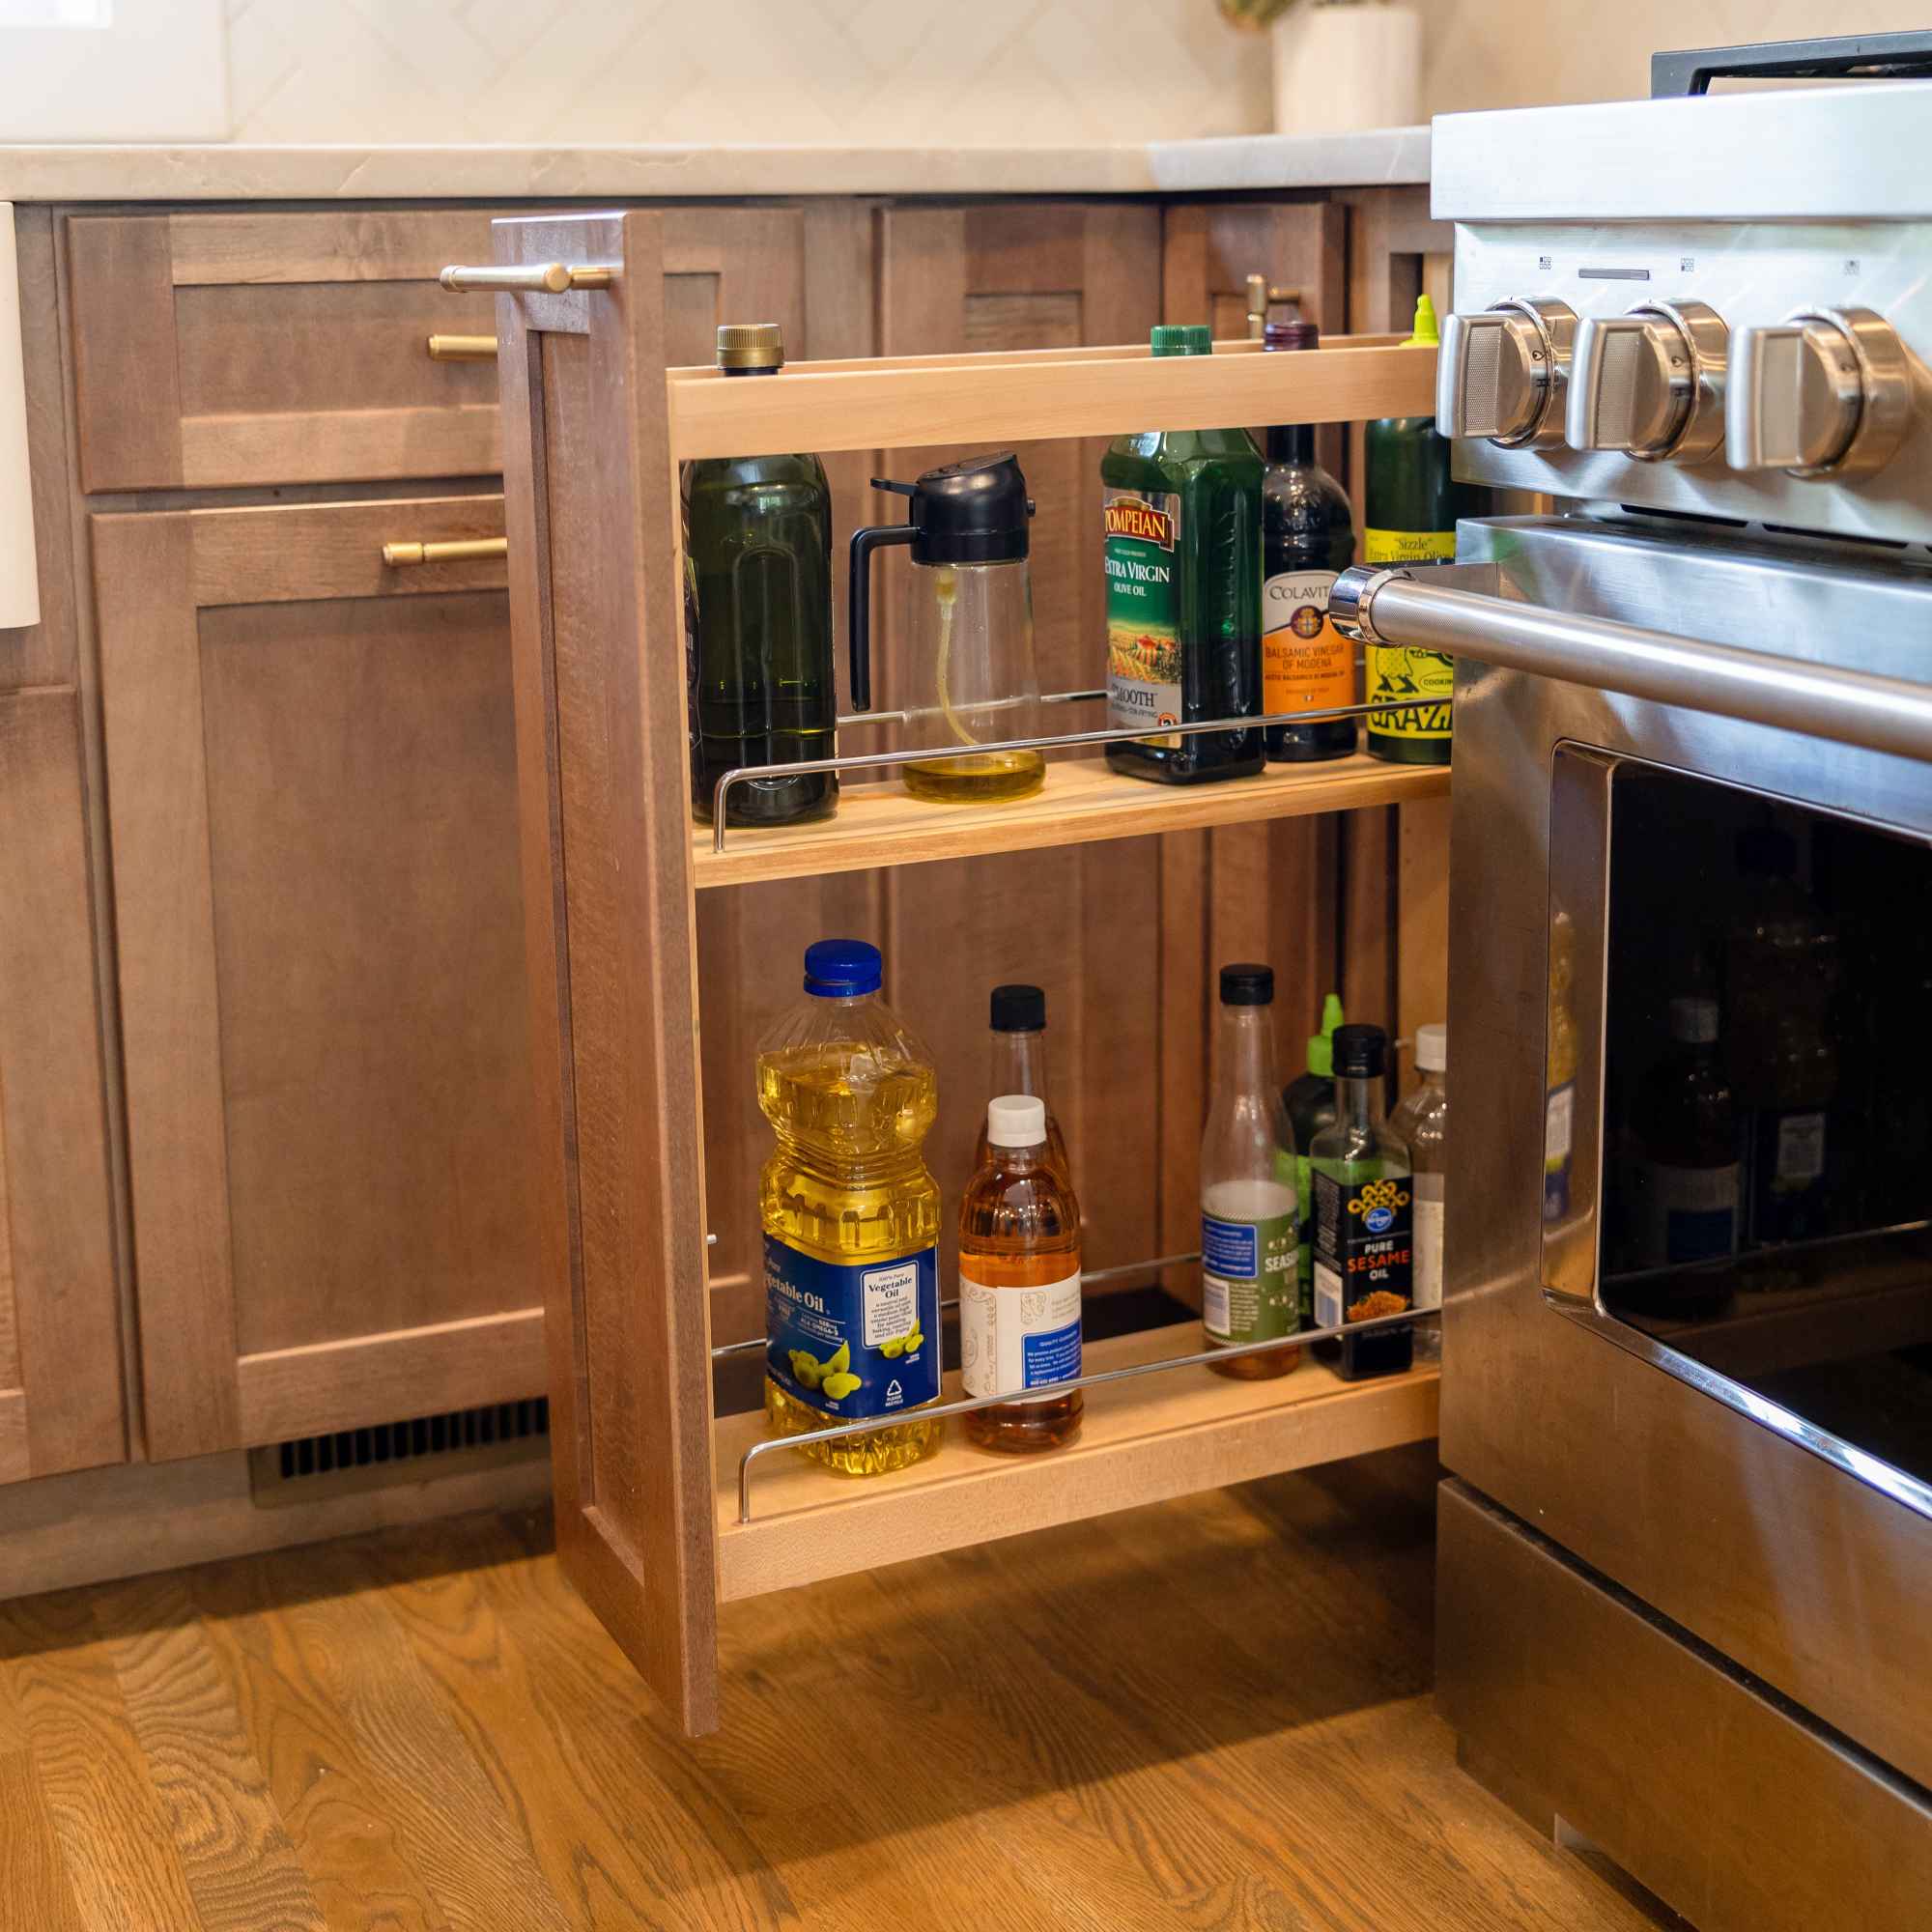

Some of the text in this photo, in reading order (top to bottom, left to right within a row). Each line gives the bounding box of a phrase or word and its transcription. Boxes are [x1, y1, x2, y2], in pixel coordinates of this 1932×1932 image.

[1127, 561, 1170, 582] VIRGIN
[1114, 582, 1147, 597] OLIVE OIL
[1270, 585, 1329, 600] COLAVIT
[1265, 643, 1344, 658] BALSAMIC VINEGAR
[1283, 659, 1331, 669] OF MODENA
[1371, 695, 1453, 730] GRAZ
[1365, 1240, 1394, 1254] PURE
[1348, 1250, 1409, 1273] SESAME
[1369, 1268, 1389, 1281] OIL
[868, 1277, 913, 1293] Vegetable
[885, 1289, 899, 1299] Oil
[804, 1293, 824, 1313] Oil
